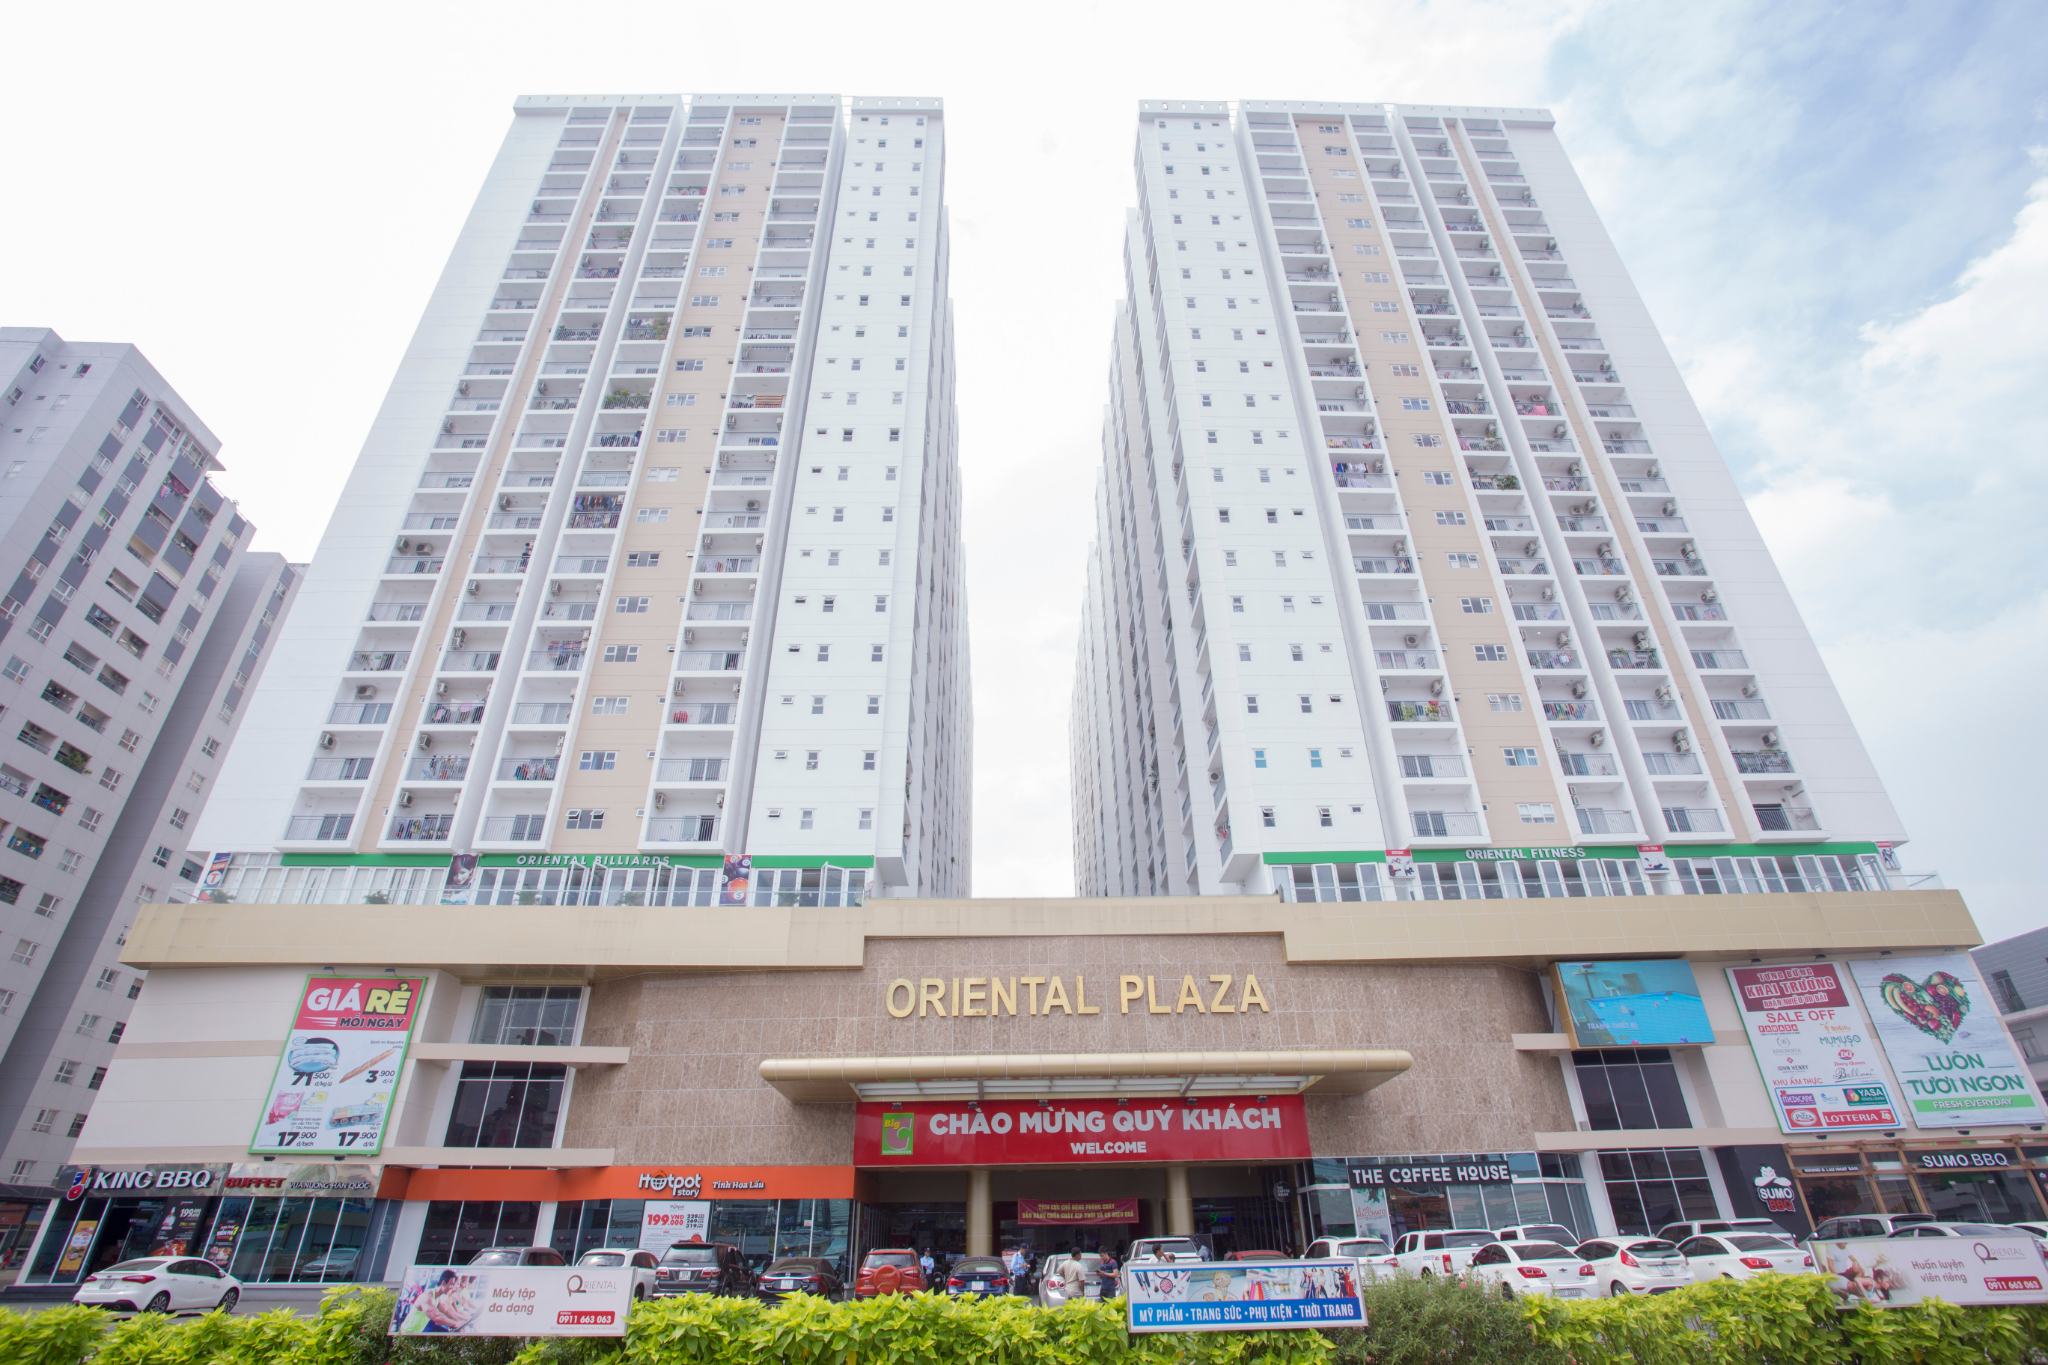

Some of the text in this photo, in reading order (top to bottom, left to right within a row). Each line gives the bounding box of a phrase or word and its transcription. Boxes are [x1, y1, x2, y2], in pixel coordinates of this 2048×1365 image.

[516, 855, 670, 865] ORIENTAL BILLIARDS
[1466, 848, 1587, 860] ORIENTAL FITNESS
[1745, 976, 1836, 998] KHAI TRƯƠNG
[307, 981, 414, 1015] GIÁ RẺ
[886, 973, 1270, 1018] ORIENTAL PLAZA
[338, 1014, 406, 1028] MỖI NGÀY
[1766, 1009, 1836, 1023] SALE OFF
[1819, 1035, 1861, 1045] MUMUSO
[1926, 1051, 1985, 1071] LUÔN
[1907, 1074, 2025, 1095] TƯƠI NGON
[1858, 1088, 1883, 1097] YASA
[1933, 1098, 2013, 1109] FRESH EVERYDAY
[929, 1103, 1282, 1135] CHÀO MỪNG QUÝ KHÁCH
[1825, 1113, 1879, 1123] LOTTERIA
[884, 1117, 912, 1150] Big C
[1070, 1141, 1147, 1155] WELCOME
[1922, 1153, 2009, 1168] SUMO BBQ
[93, 1170, 212, 1189] KING BBQ
[1352, 1168, 1384, 1184] THE
[224, 1177, 286, 1189] BUFFET
[638, 1170, 702, 1196] Hotpot
[732, 1181, 748, 1189] Hoa
[677, 1188, 700, 1198] story
[1759, 1187, 1793, 1200] SUMO
[1769, 1199, 1795, 1211] BBQ
[612, 1235, 635, 1245] Hotpot
[1911, 1258, 1965, 1271] Huấn luyện
[1920, 1272, 1968, 1283] viên riêng
[1987, 1281, 2040, 1290] 0911 663 063
[492, 1288, 536, 1301] Máy tập
[488, 1302, 534, 1315] đa dạng
[1140, 1302, 1354, 1322] MỸ PHẨM TRANG SỨC PHỤ KIỆN THỜI TRANG
